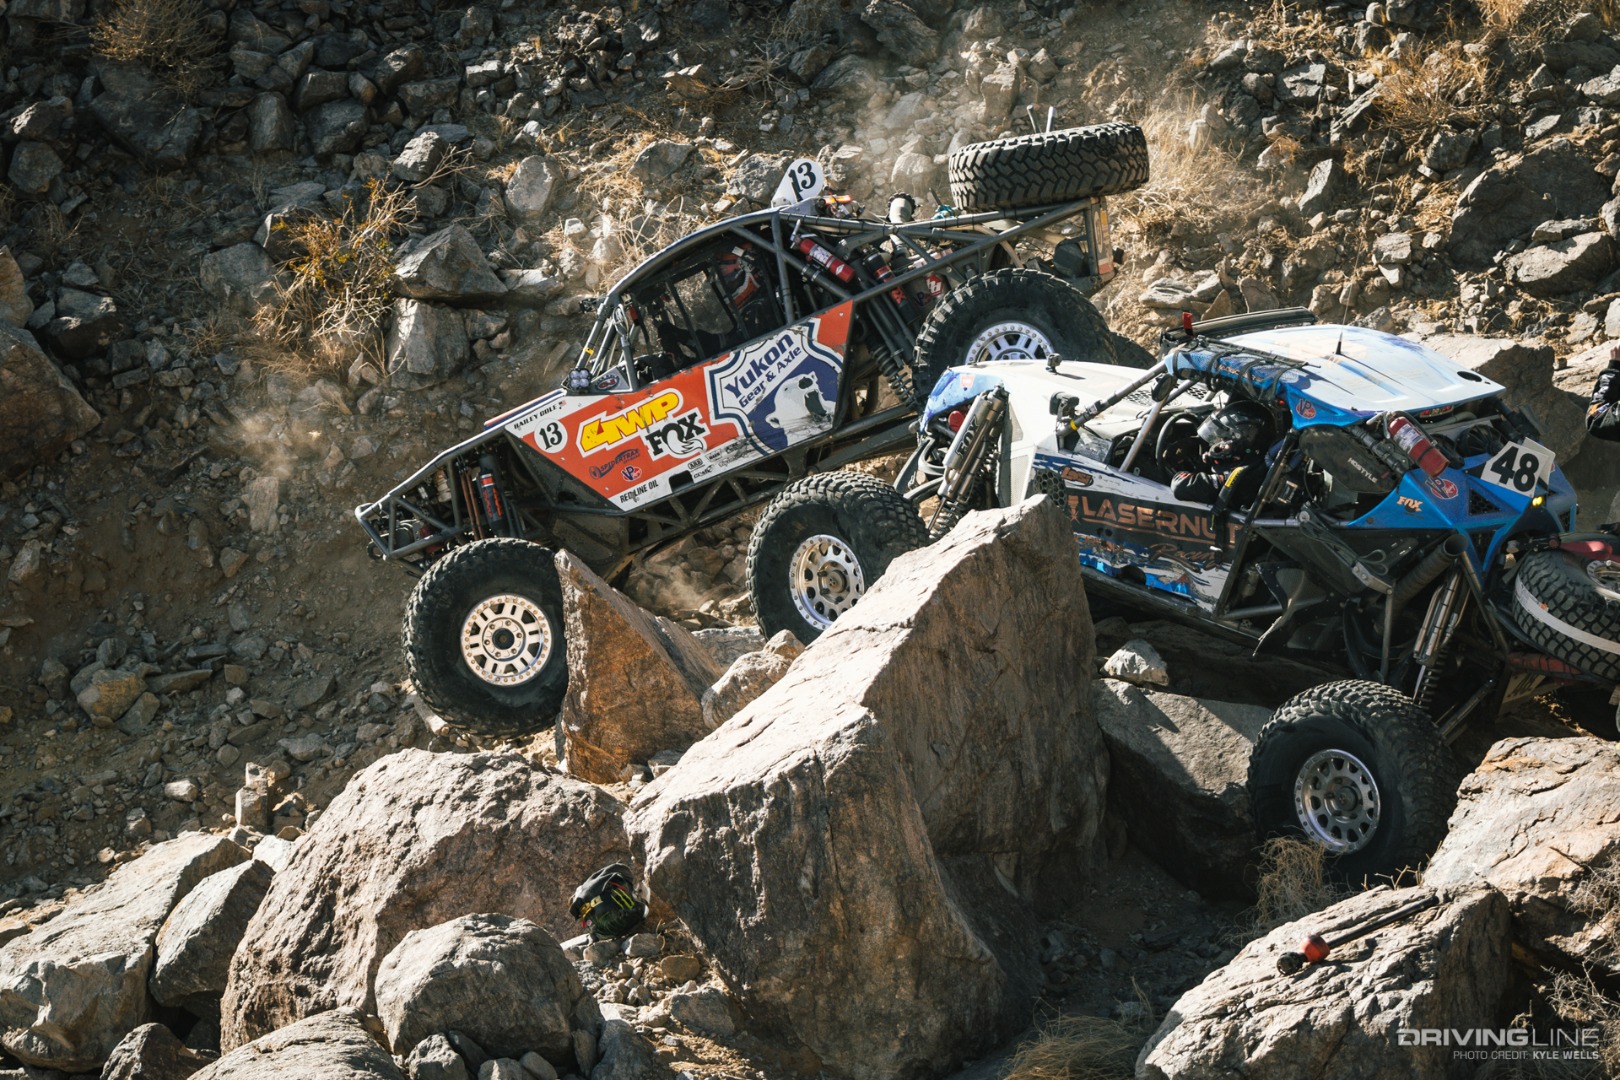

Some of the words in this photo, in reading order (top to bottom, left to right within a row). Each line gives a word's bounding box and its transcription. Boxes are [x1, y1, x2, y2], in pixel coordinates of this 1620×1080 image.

[788, 161, 816, 202] 13
[724, 334, 794, 399] Yukon
[738, 381, 765, 408] Gear
[765, 370, 776, 383] &
[777, 347, 802, 374] Axle
[513, 413, 539, 430] BAILEY
[539, 422, 563, 450] 13
[580, 392, 680, 453] 4WP
[645, 412, 706, 457] FOX
[955, 414, 980, 457] FOX
[621, 465, 635, 481] VP
[648, 479, 659, 490] OIL
[1425, 477, 1448, 499] VP
[1490, 446, 1540, 492] 48
[1396, 495, 1423, 512] FOX
